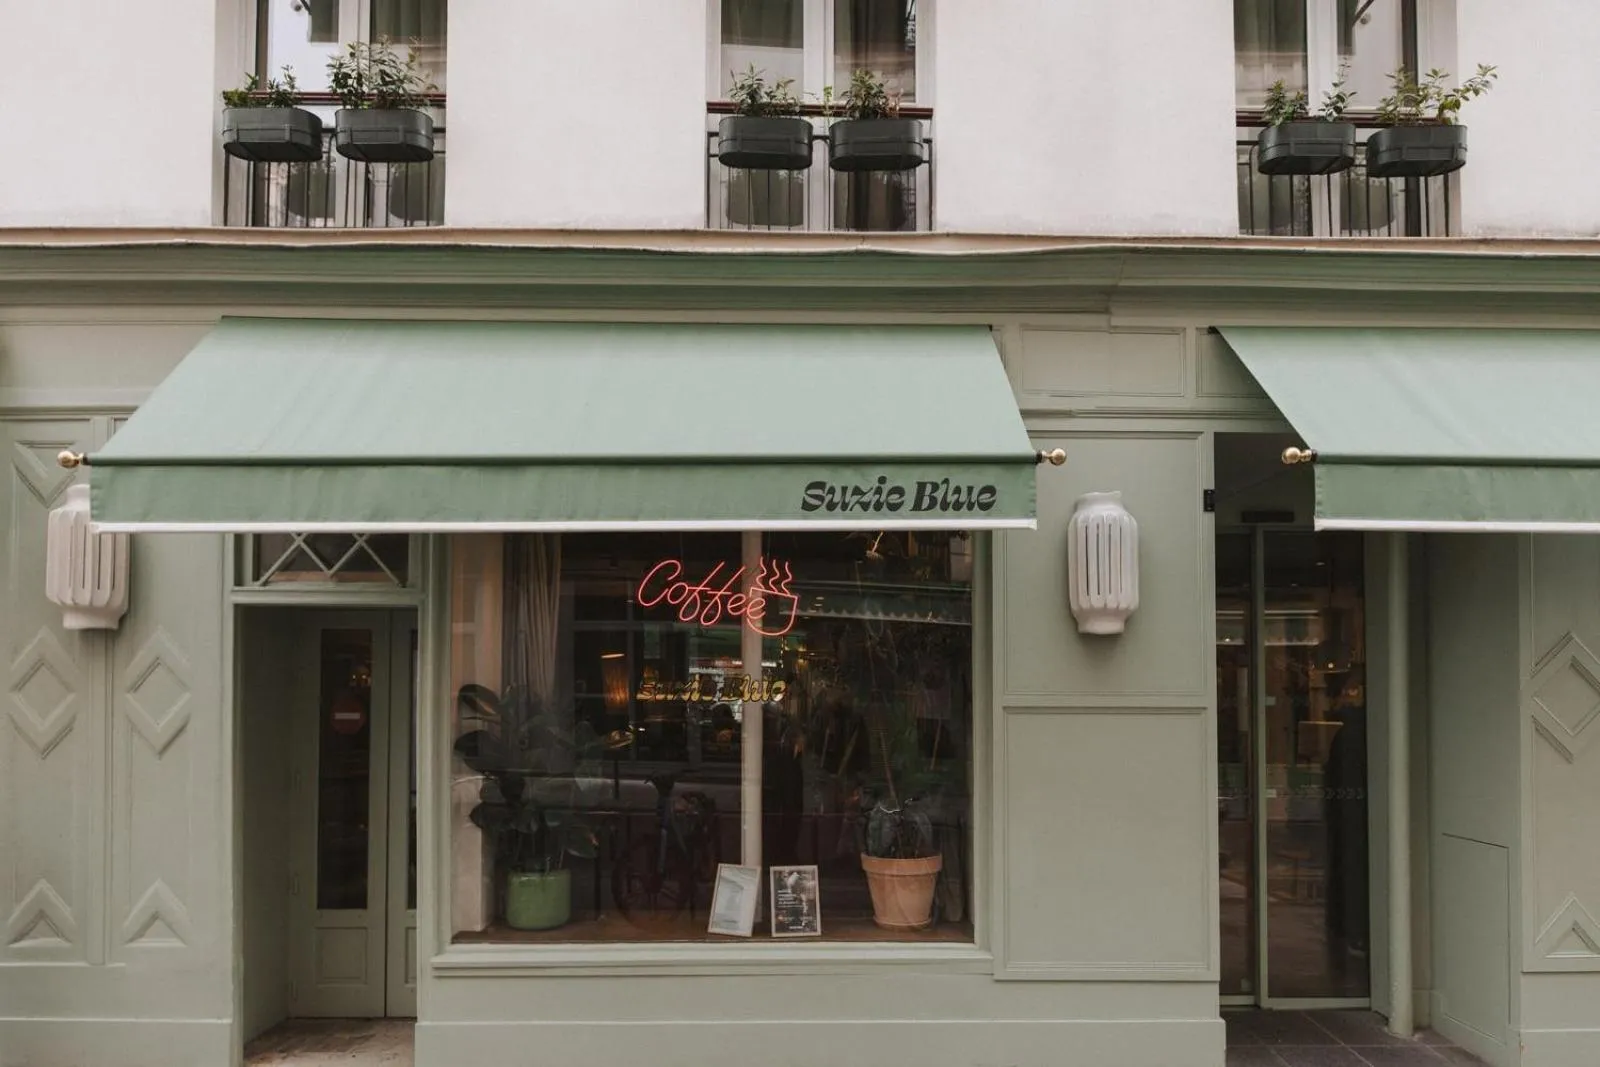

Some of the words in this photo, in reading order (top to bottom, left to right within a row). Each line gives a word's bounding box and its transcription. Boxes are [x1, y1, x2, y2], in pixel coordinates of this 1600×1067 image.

[801, 475, 906, 512] Suzie
[909, 477, 998, 512] Blue
[638, 559, 767, 626] Coffee
